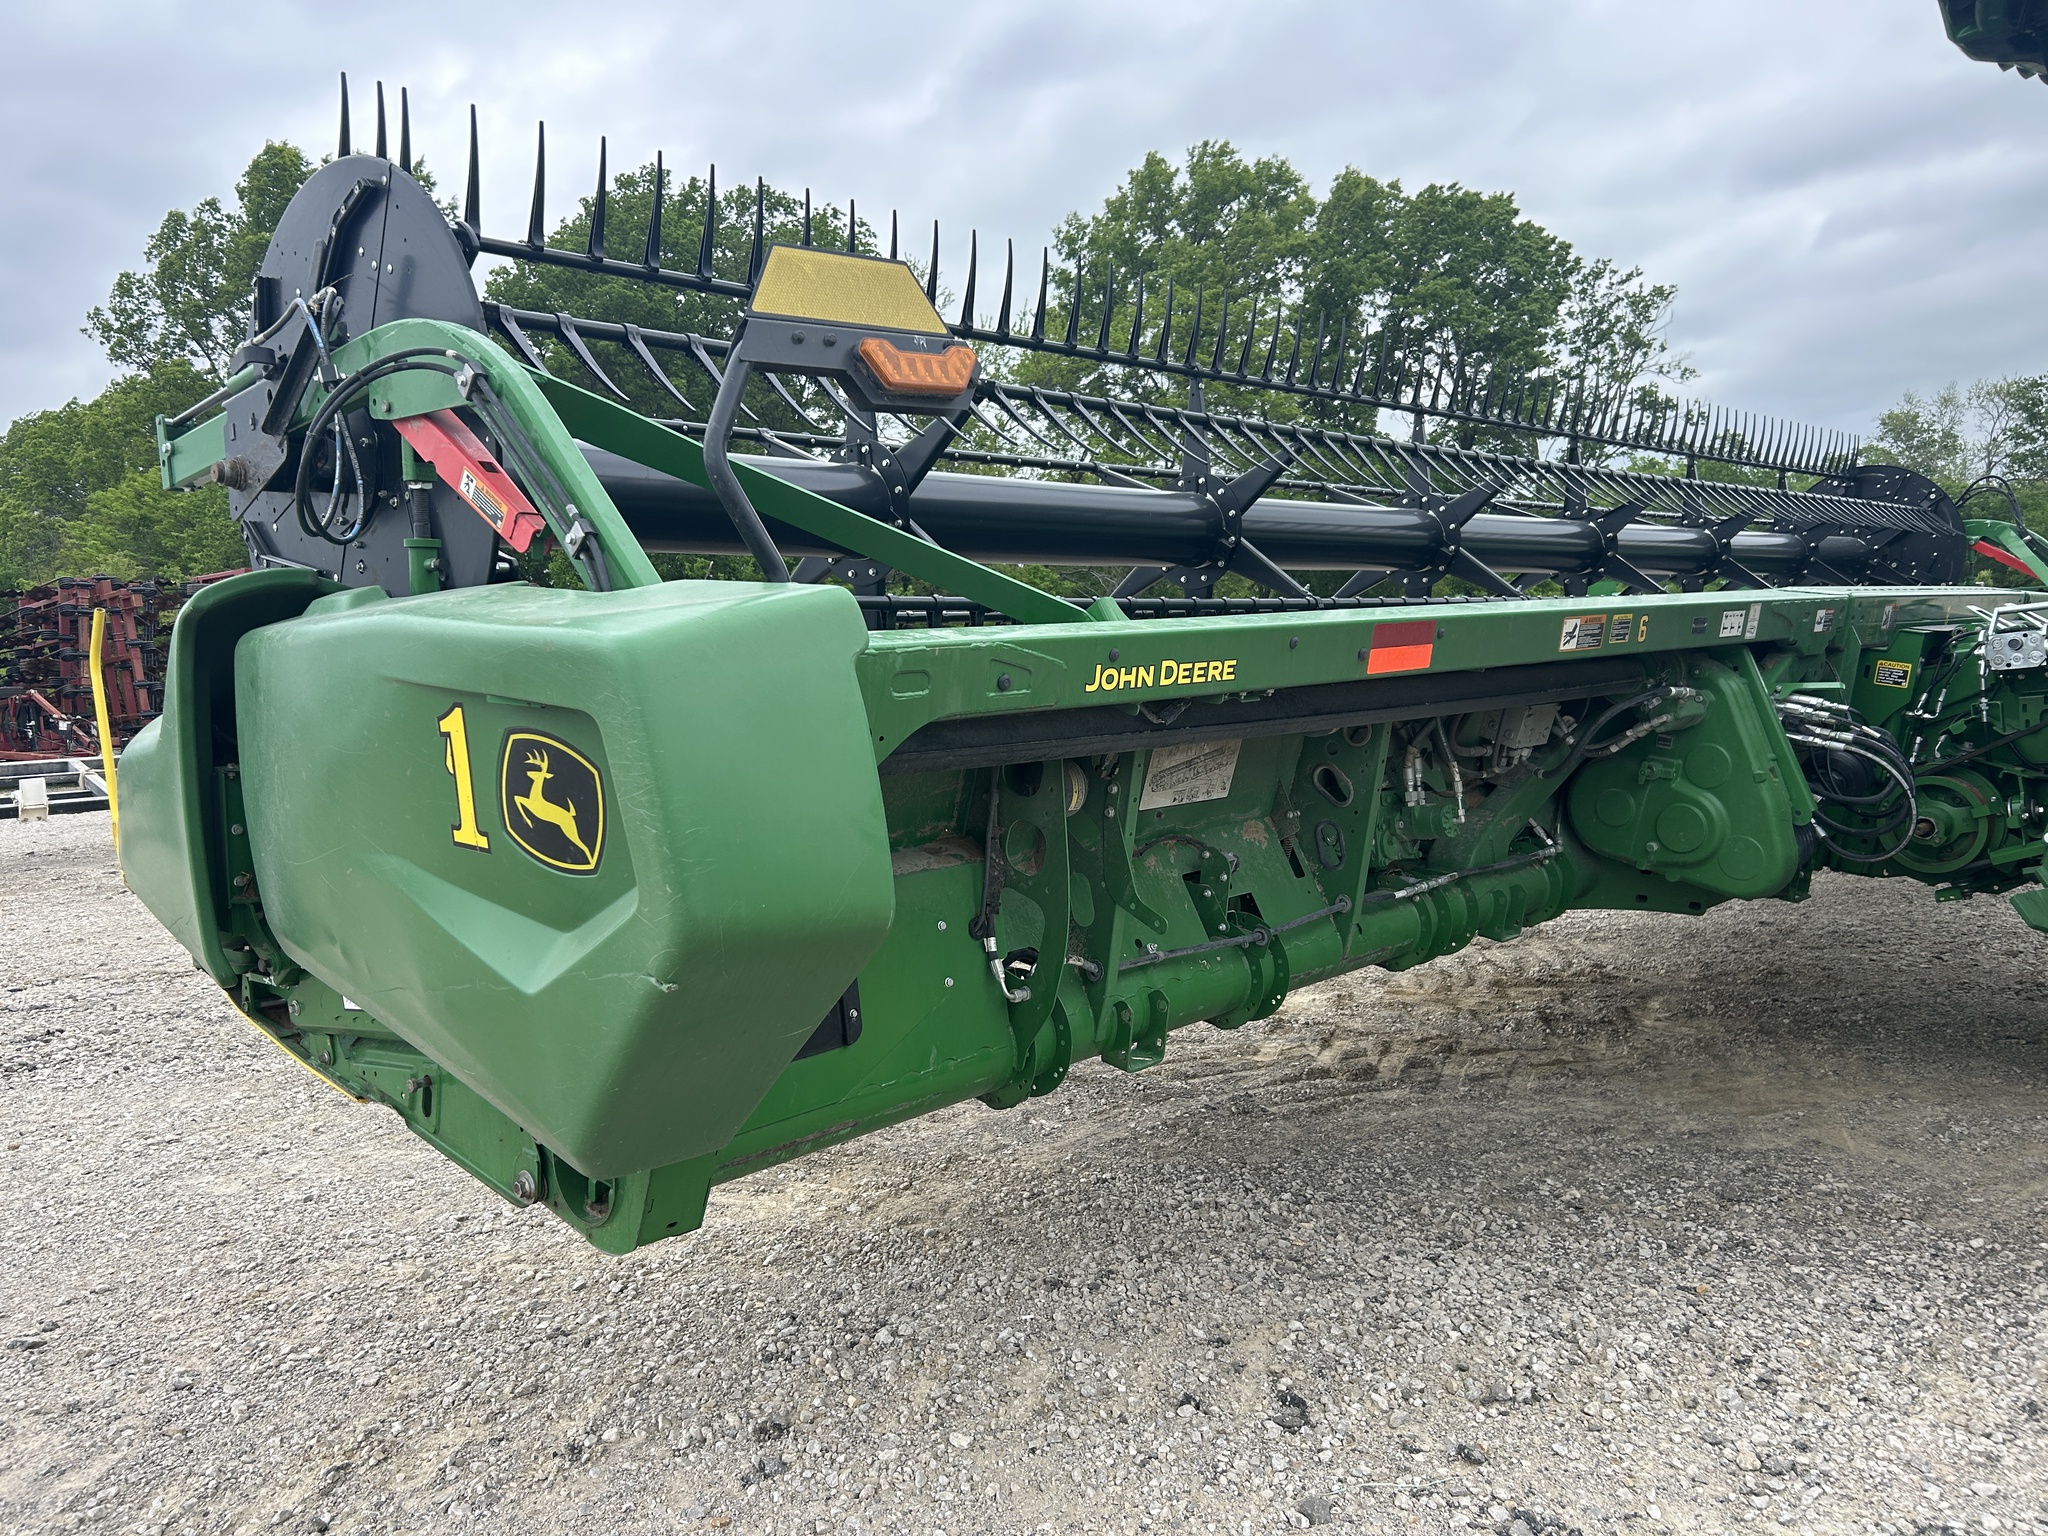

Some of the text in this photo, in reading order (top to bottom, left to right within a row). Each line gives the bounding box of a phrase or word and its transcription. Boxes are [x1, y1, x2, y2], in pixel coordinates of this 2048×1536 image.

[1637, 613, 1649, 643] 6
[1084, 658, 1238, 693] JOHN DEERE
[1883, 661, 1910, 670] CAUTION
[436, 702, 492, 855] 1
